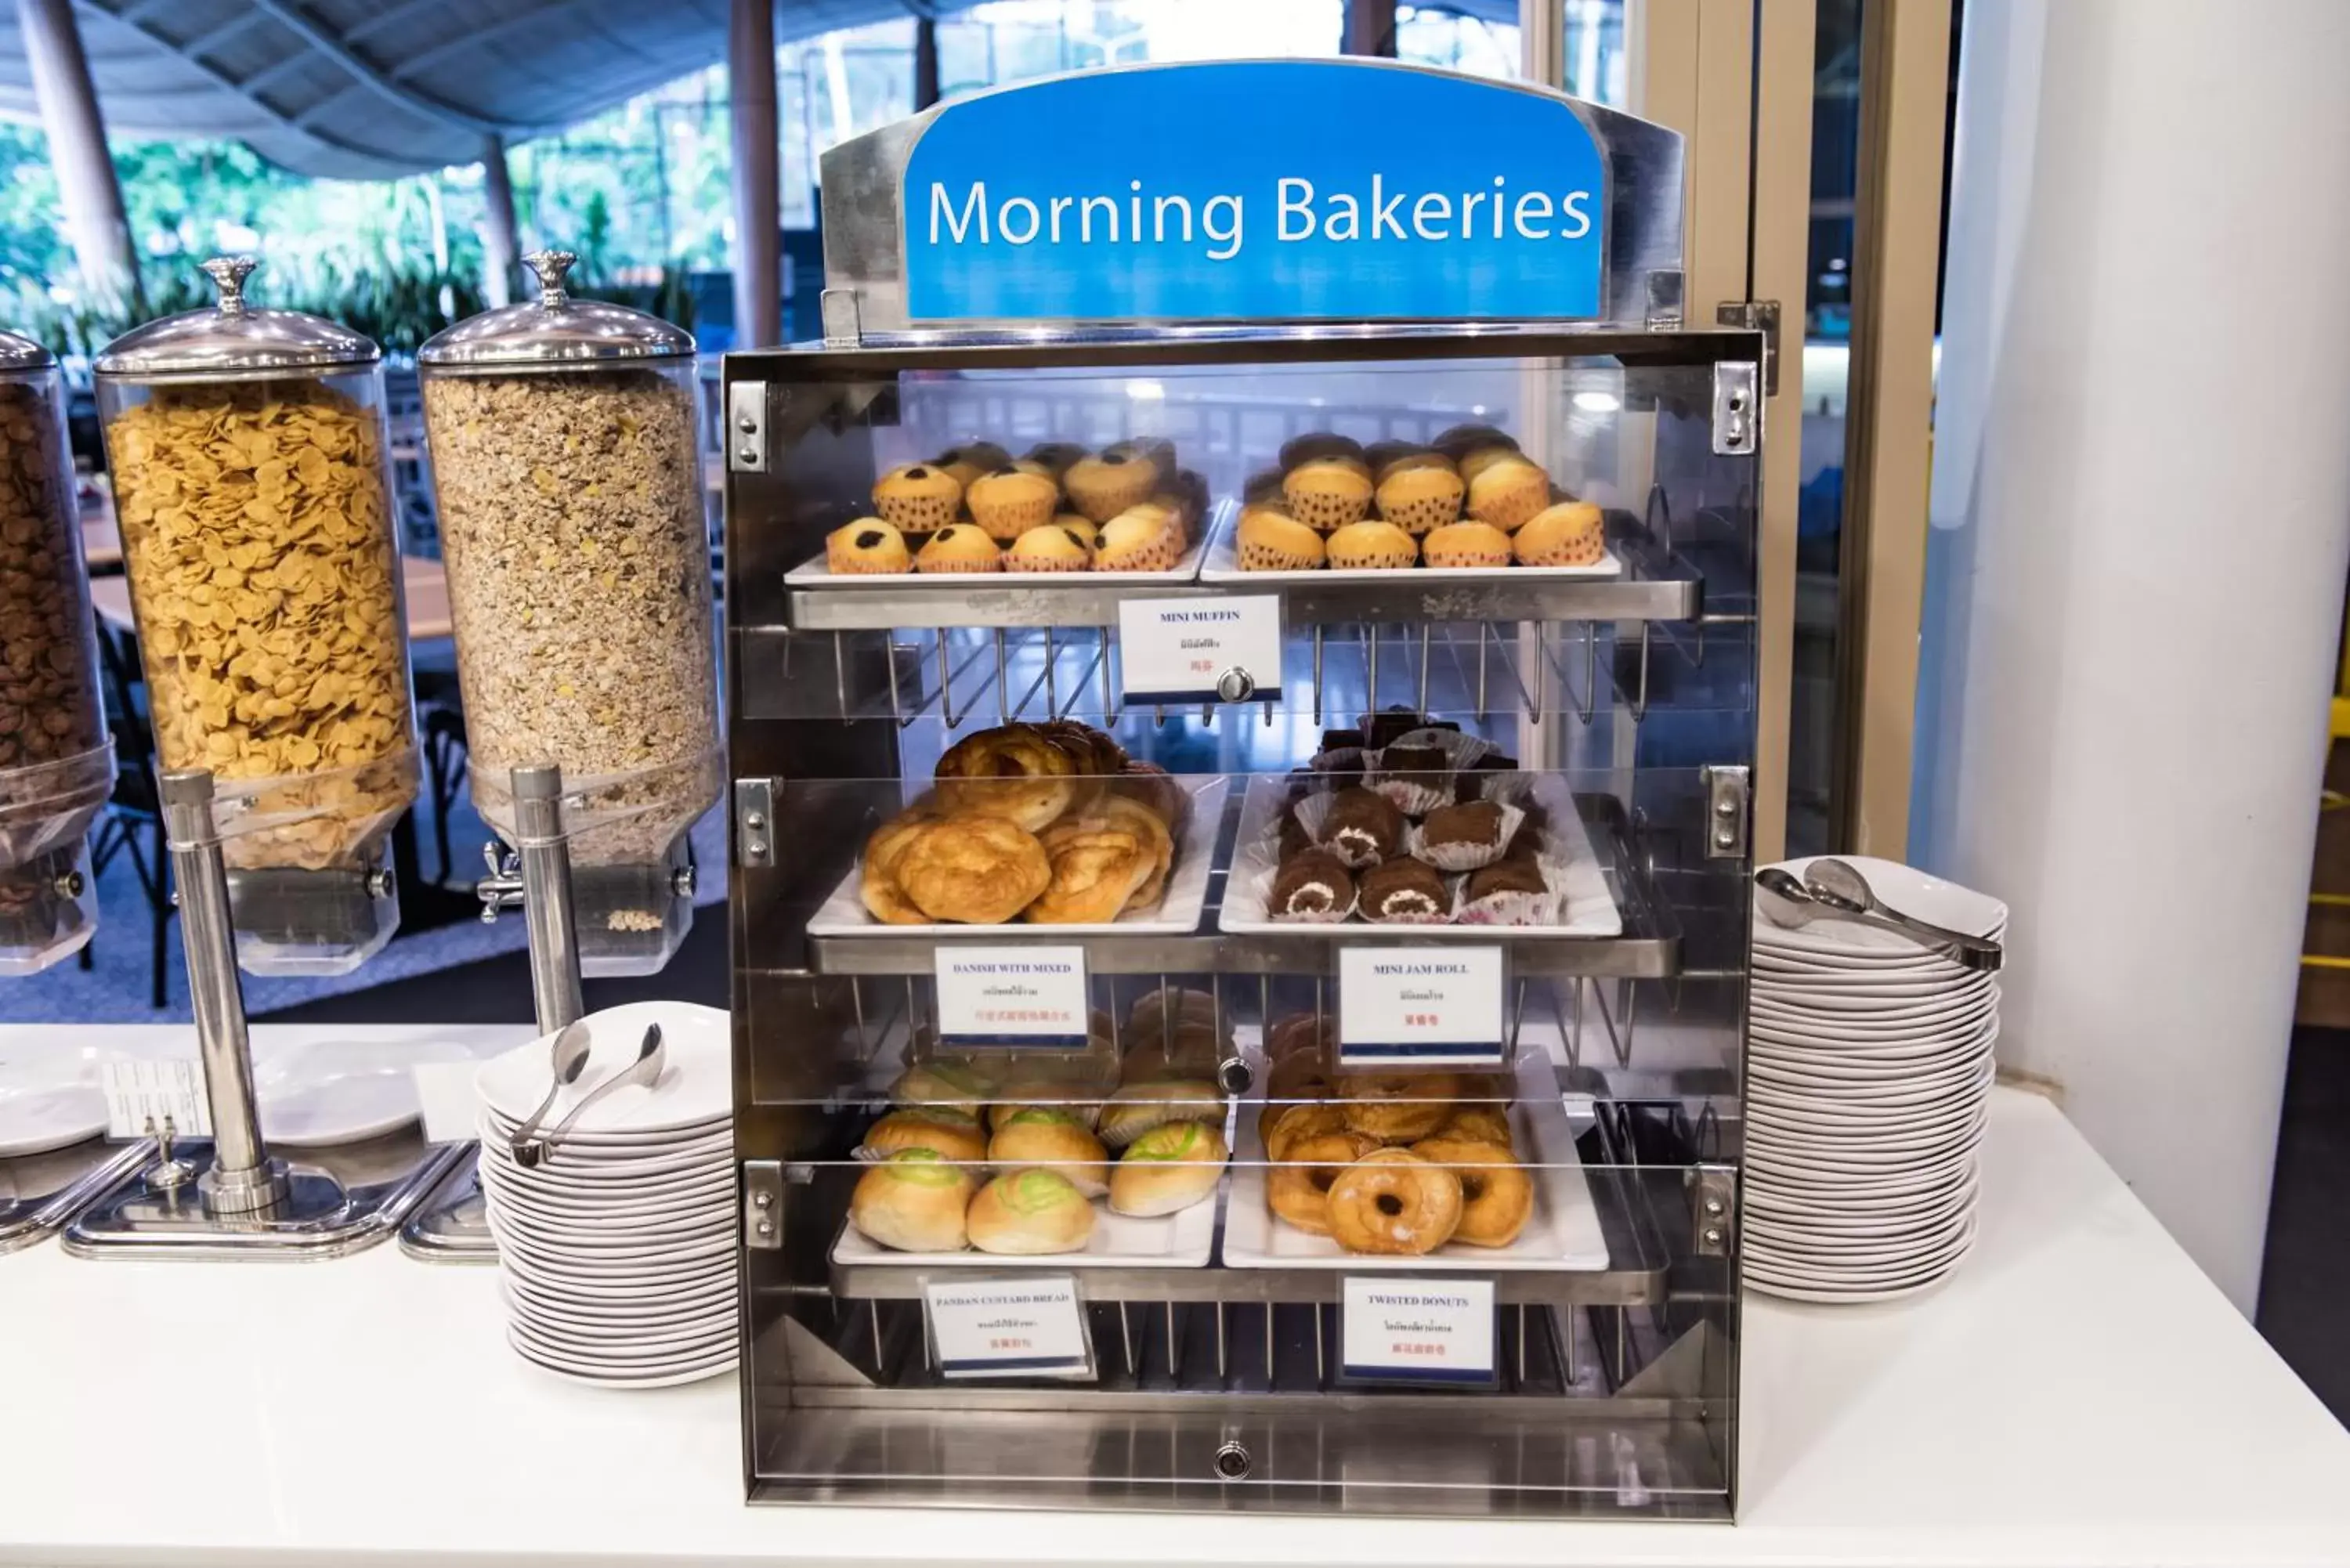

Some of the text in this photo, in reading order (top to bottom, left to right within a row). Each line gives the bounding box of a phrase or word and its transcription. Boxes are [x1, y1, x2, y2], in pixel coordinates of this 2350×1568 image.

[929, 174, 1591, 260] Morning Bakeries
[1160, 610, 1242, 623] MINI MUFFIN
[953, 963, 1072, 974] DANISH WITH MIXED
[1373, 964, 1469, 974] MINI JAM ROLL
[936, 1293, 1069, 1306] PANDAN CUSTARD BREAD
[1368, 1295, 1469, 1307] TWISTED DONUTS
